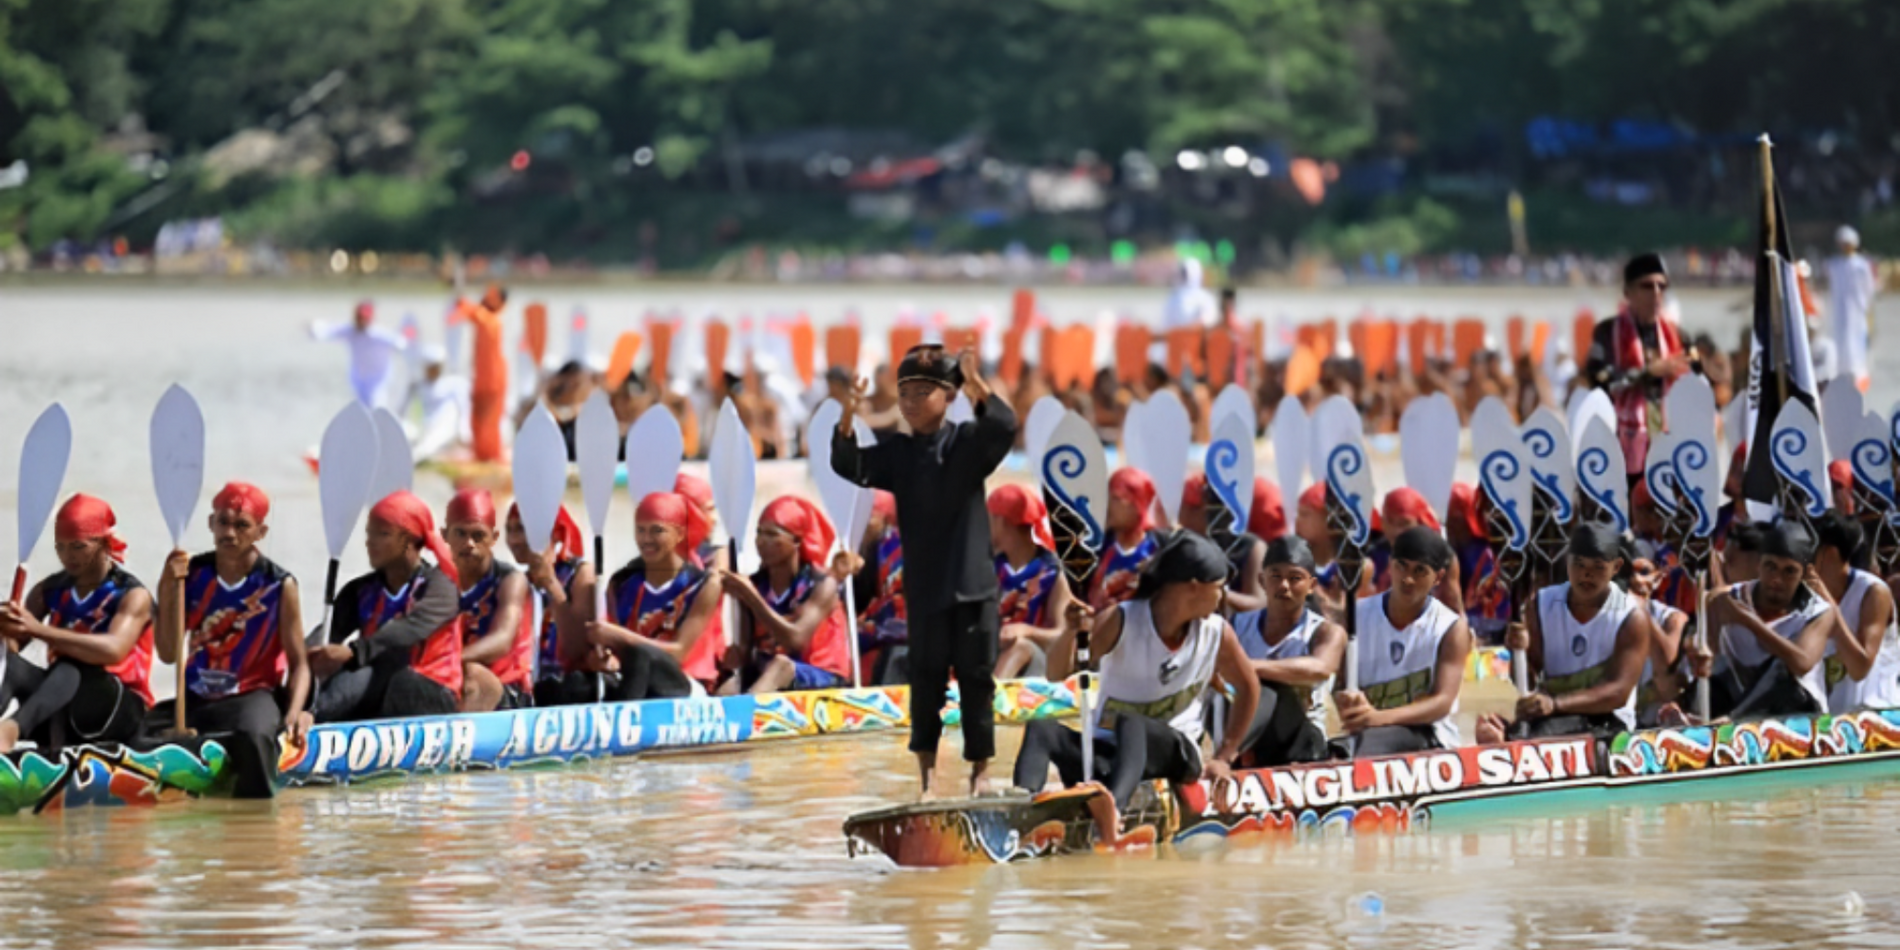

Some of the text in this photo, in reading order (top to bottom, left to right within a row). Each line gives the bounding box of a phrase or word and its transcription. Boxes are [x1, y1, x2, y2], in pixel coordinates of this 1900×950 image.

[313, 703, 642, 773] POWER AGUNG
[1477, 741, 1591, 785] SATI
